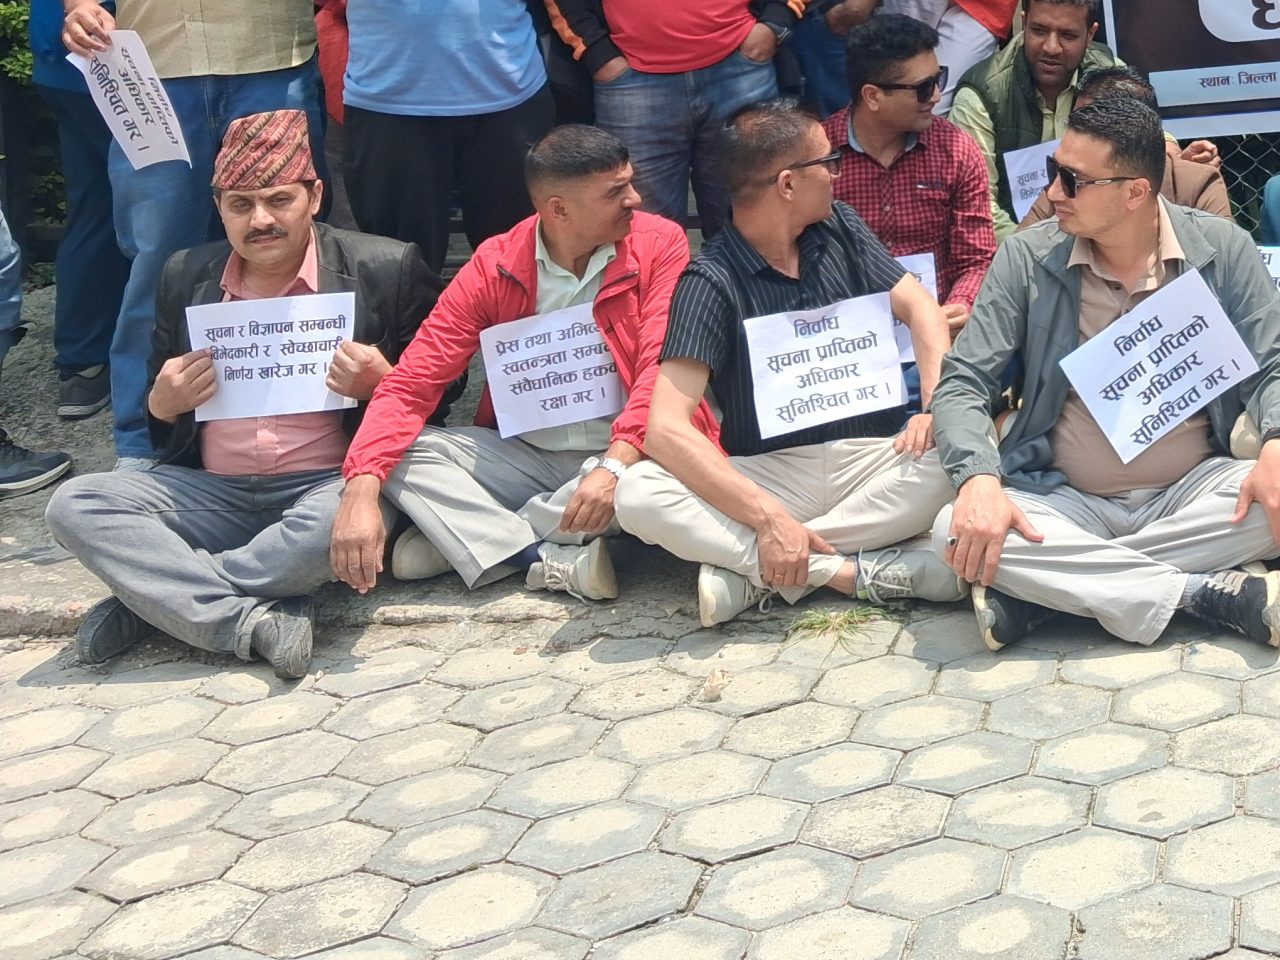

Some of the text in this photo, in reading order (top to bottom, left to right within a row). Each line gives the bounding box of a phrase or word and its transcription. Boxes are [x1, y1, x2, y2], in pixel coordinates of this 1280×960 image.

[1237, 71, 1277, 85] जिल्ला
[204, 314, 346, 342] सूचना र विज्ञापन सम्बन्धी
[263, 344, 271, 357] र
[496, 340, 520, 356] प्रेस
[524, 331, 552, 349] तथा
[765, 330, 878, 373] सूचना प्राप्तिको
[224, 362, 318, 382] निर्णय खारेज गर
[502, 350, 567, 376] स्वतन्त्रता
[1099, 315, 1210, 402] सूचना प्राप्तिको
[795, 362, 861, 389] अधिकार
[1136, 350, 1204, 406] अधिकार
[539, 389, 594, 411] रक्षा गर
[775, 385, 879, 423] सुनिश्चित गर
[1130, 364, 1230, 445] सुनिश्चित गर
